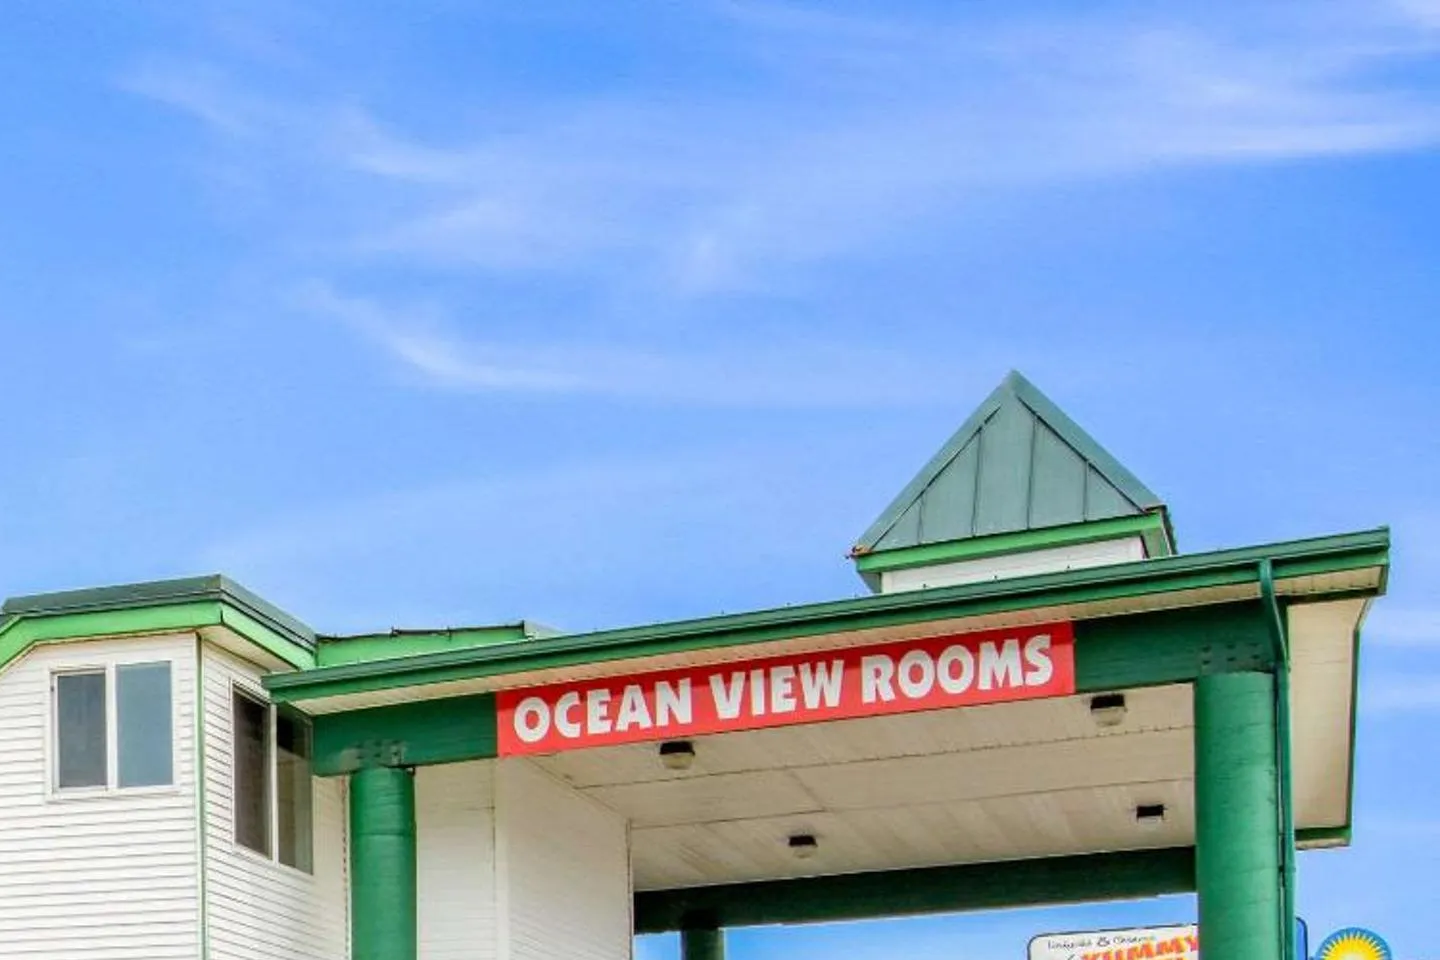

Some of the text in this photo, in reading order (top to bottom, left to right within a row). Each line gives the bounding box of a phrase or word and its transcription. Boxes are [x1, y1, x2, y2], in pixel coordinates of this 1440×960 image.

[512, 634, 1053, 743] OCEAN VIEW ROOMS
